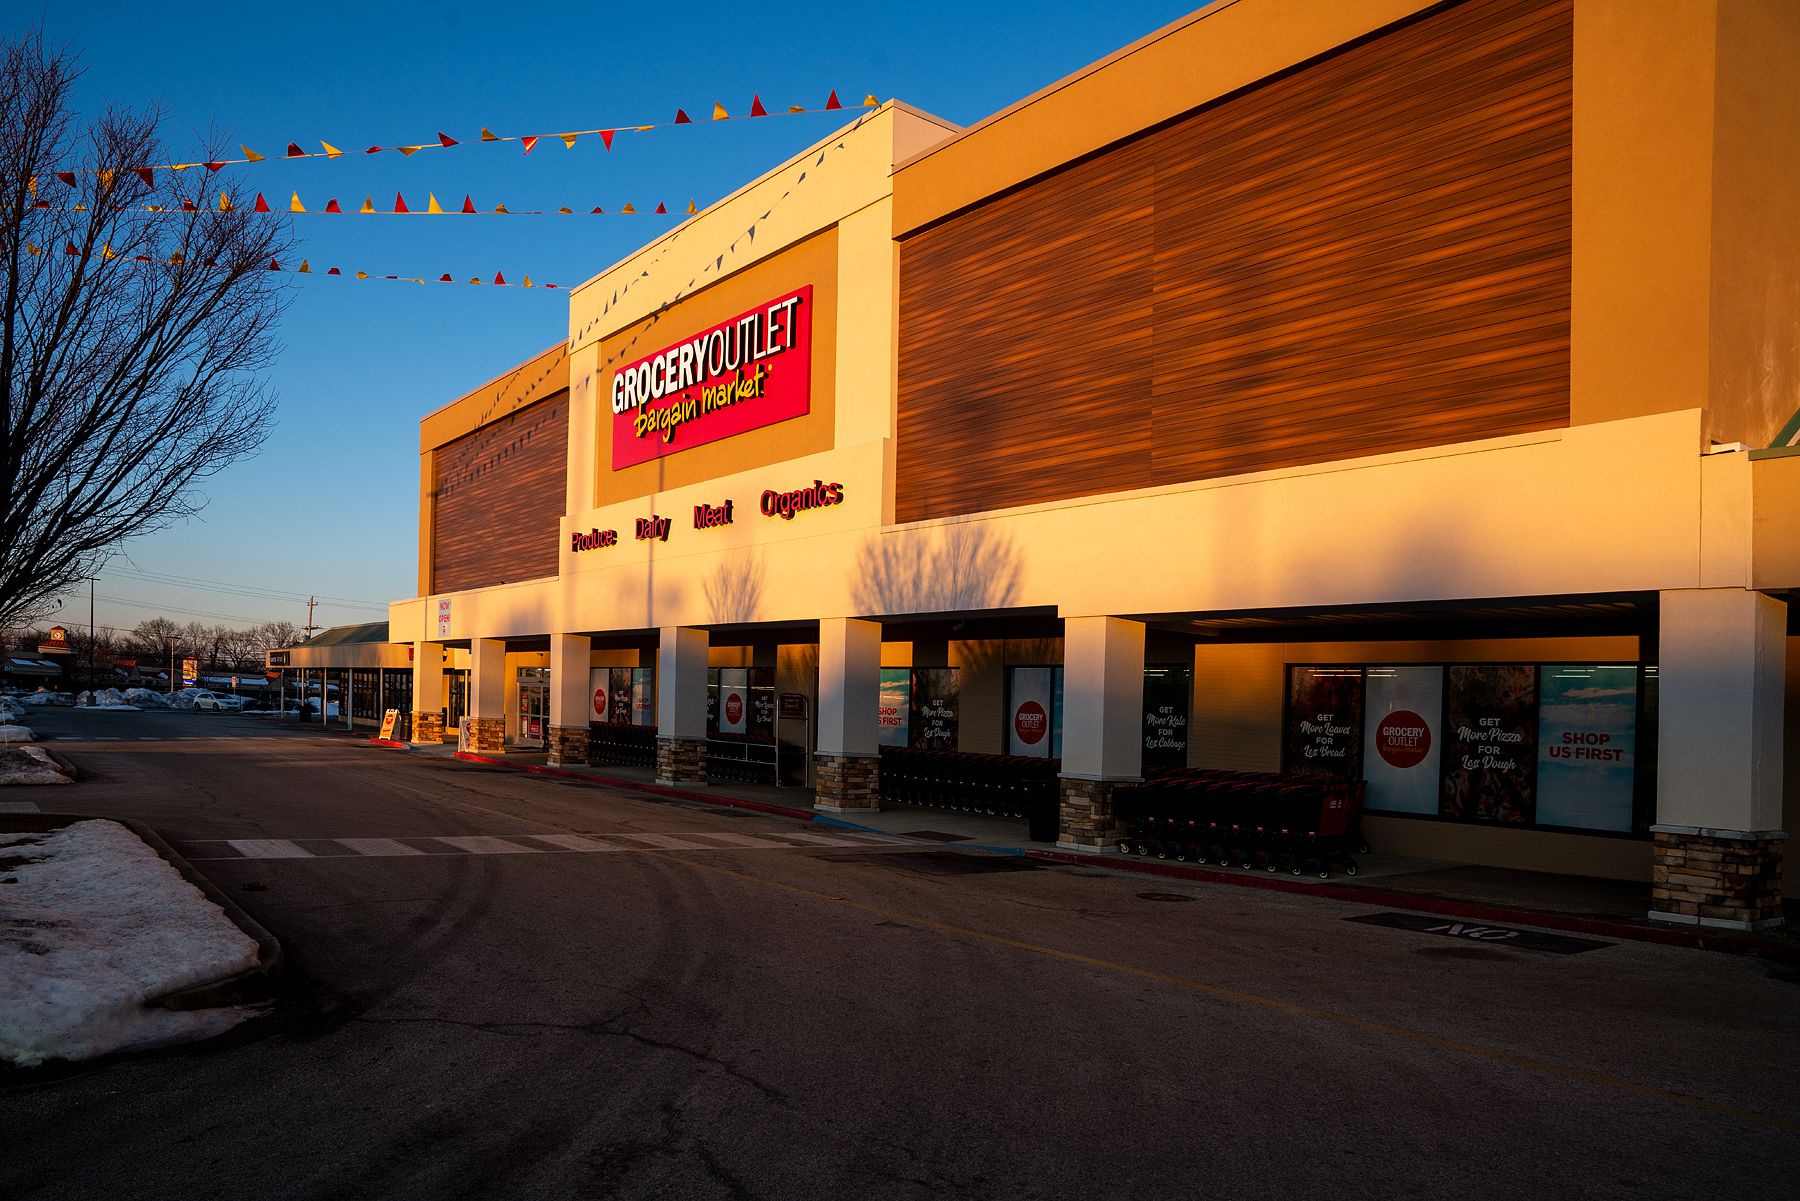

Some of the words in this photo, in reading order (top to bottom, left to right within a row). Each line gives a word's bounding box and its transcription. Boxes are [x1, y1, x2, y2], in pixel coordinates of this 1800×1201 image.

[633, 393, 699, 443] bargain
[702, 363, 765, 414] market
[572, 528, 617, 552] Produce
[635, 515, 671, 541] Dairy
[694, 499, 733, 529] Meat
[760, 480, 843, 520] Organics
[1158, 706, 1174, 714] GET
[1019, 713, 1044, 721] GROCERY
[1146, 713, 1167, 727] More
[1167, 715, 1187, 728] Kale
[1316, 713, 1334, 721] GET
[1479, 717, 1501, 727] GET
[1158, 728, 1174, 736] FOR
[1300, 720, 1323, 735] More
[1323, 722, 1351, 736] Loaves
[1382, 726, 1425, 738] GROCERY
[1457, 725, 1488, 742] More
[1488, 727, 1522, 743] Pizza
[1158, 737, 1186, 751] Cabbage
[1315, 737, 1334, 745] FOR
[1388, 736, 1420, 747] OUTLET
[1562, 732, 1610, 745] SHOP
[1319, 745, 1346, 758] Bread
[1477, 745, 1501, 755] FOR
[1550, 746, 1571, 758] US
[1575, 747, 1623, 761] FIRST
[1461, 754, 1480, 770] Less
[1482, 756, 1516, 773] Dough
